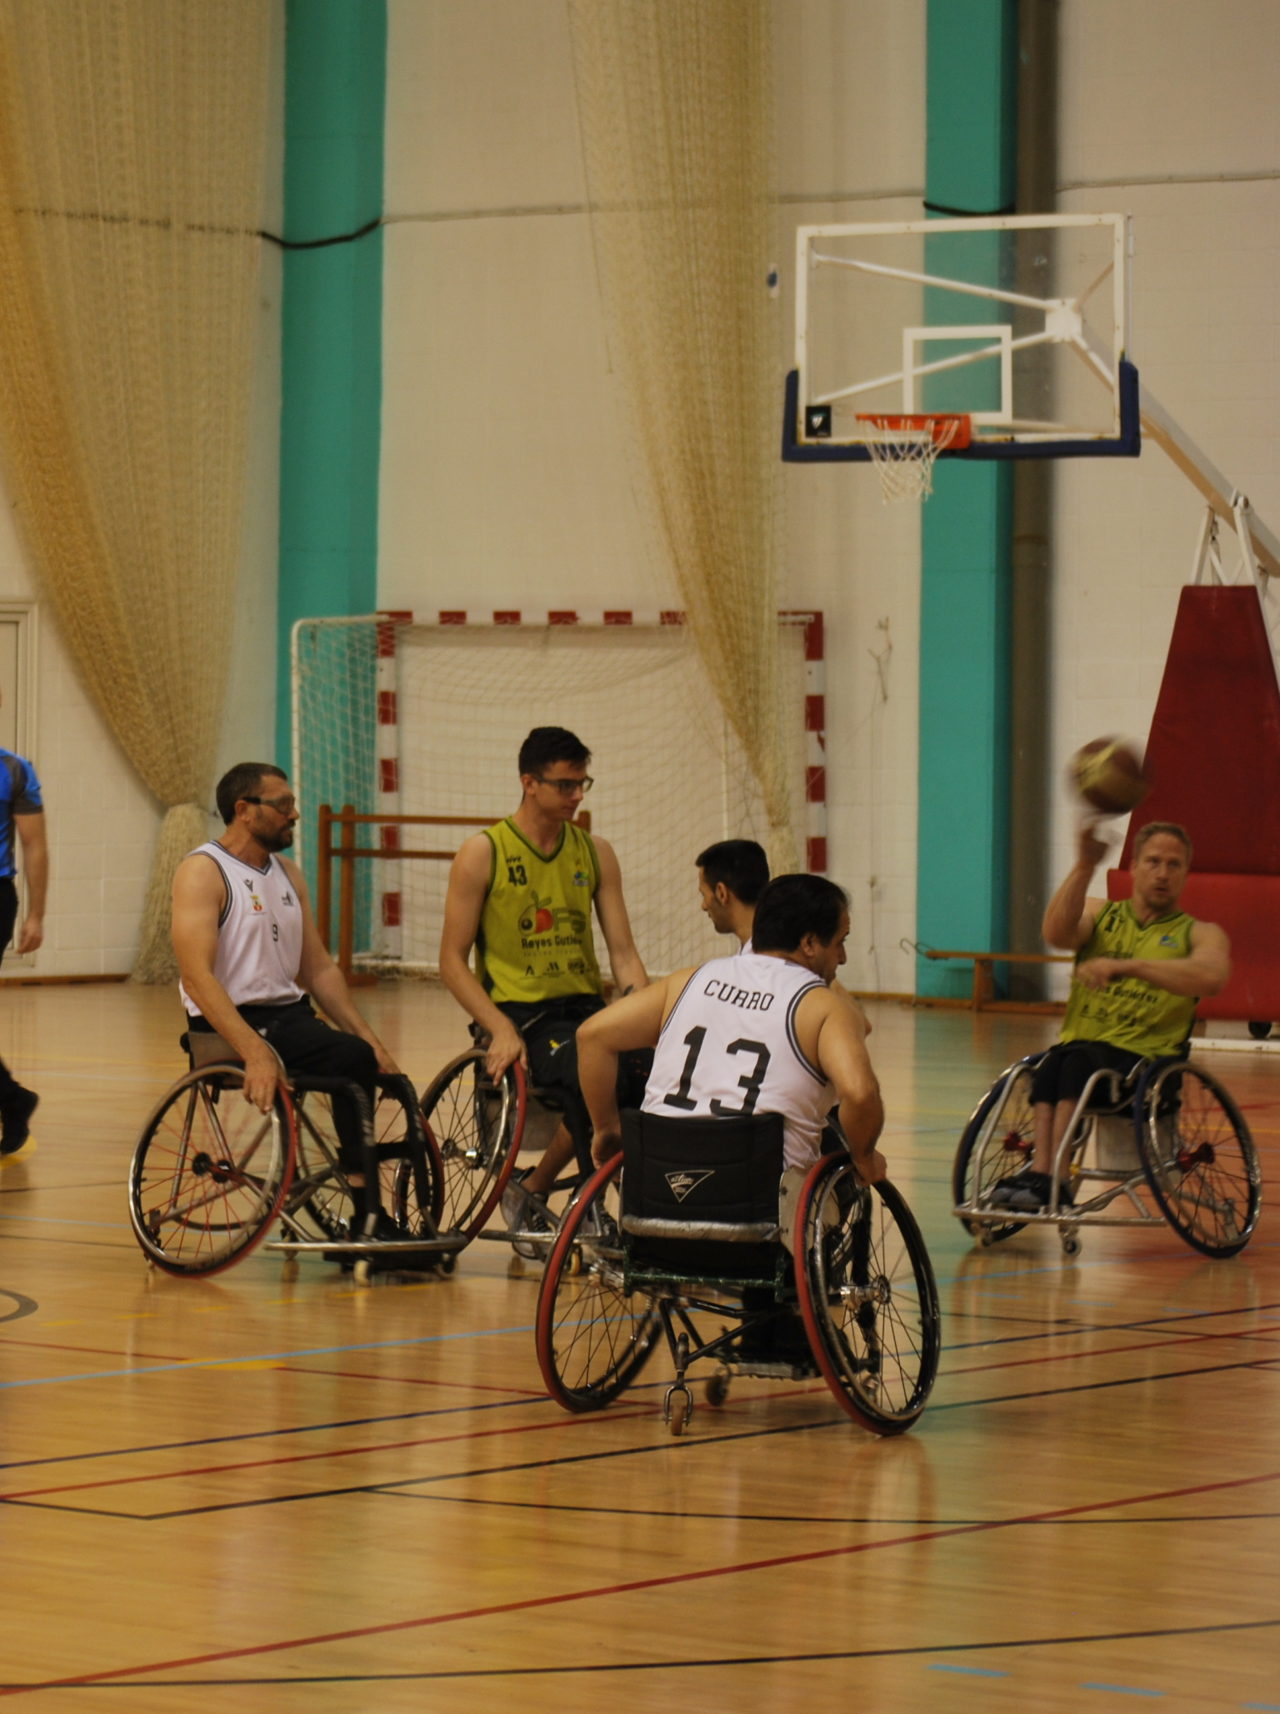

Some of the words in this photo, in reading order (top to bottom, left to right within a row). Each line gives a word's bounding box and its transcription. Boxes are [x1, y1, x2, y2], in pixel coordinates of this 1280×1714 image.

[508, 865, 528, 887] 43
[272, 923, 279, 943] 9
[521, 938, 552, 949] Reyes
[704, 979, 775, 1012] CURRO
[663, 1025, 772, 1117] 13
